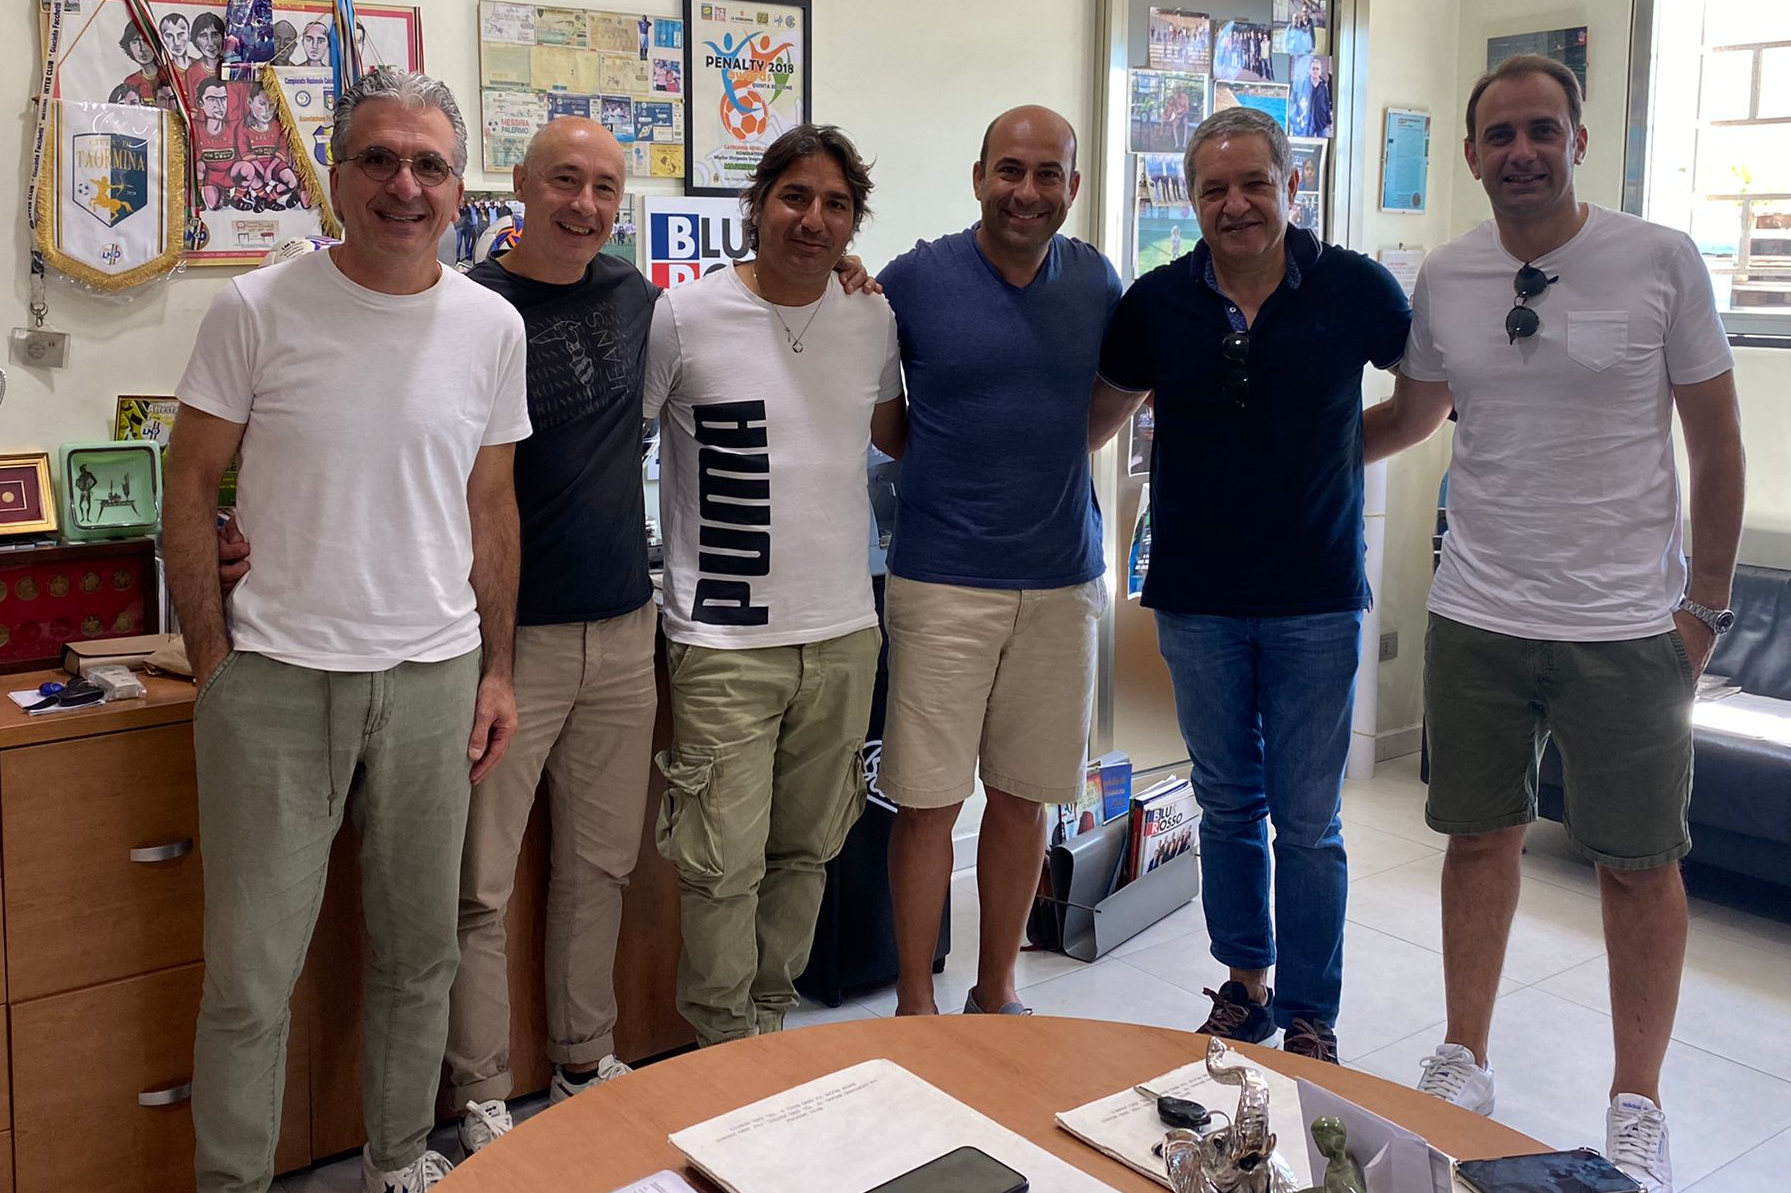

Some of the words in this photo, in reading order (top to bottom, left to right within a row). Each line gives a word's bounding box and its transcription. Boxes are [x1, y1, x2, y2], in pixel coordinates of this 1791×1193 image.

[46, 60, 54, 76] CLUB
[705, 56, 765, 72] PENALTY
[768, 62, 794, 74] 2018
[43, 76, 52, 94] INTER
[752, 82, 771, 90] QUINTA
[501, 118, 530, 127] MESSINA
[76, 149, 146, 172] TAORMINA
[667, 215, 751, 259] BLU
[585, 311, 630, 394] JEANS
[142, 427, 160, 435] LND
[691, 399, 771, 626] PUMA
[1151, 812, 1183, 834] ROSSO
[1153, 806, 1173, 822] BLU
